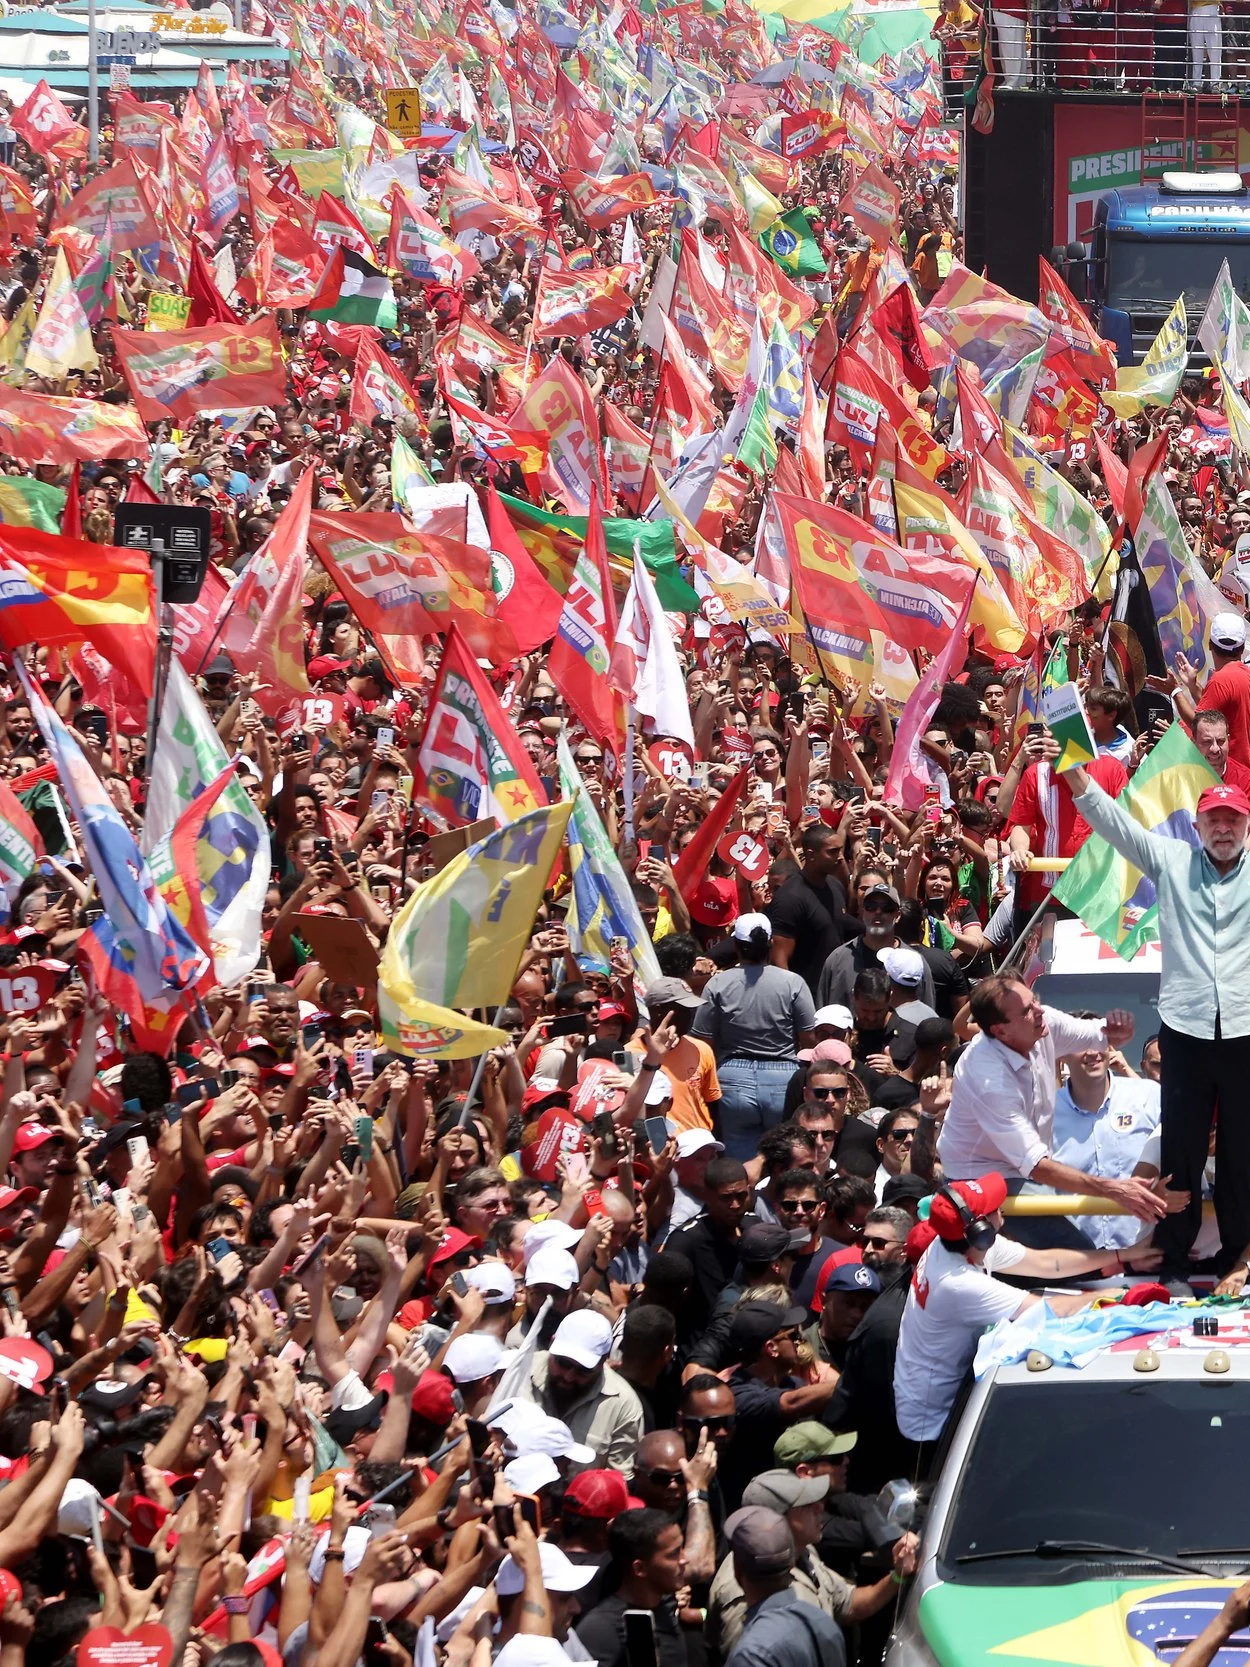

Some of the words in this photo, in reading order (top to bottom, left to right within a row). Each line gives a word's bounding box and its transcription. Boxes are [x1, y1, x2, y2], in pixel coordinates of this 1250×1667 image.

[389, 90, 417, 99] PEDESTRE
[787, 125, 819, 153] LULA
[1070, 133, 1210, 182] PRESIDENTE
[853, 183, 897, 210] LULA
[610, 222, 623, 236] 13
[151, 296, 189, 319] SUAS
[225, 338, 268, 364] 13
[837, 397, 876, 433] LUL
[907, 422, 944, 465] 13
[1071, 443, 1086, 461] 13
[340, 553, 439, 585] LULA
[302, 698, 334, 726] 13
[730, 834, 764, 871] 13
[703, 901, 720, 911] LULA
[0, 976, 41, 1013] 13
[399, 1028, 441, 1045] LULA
[1117, 1114, 1133, 1127] 13
